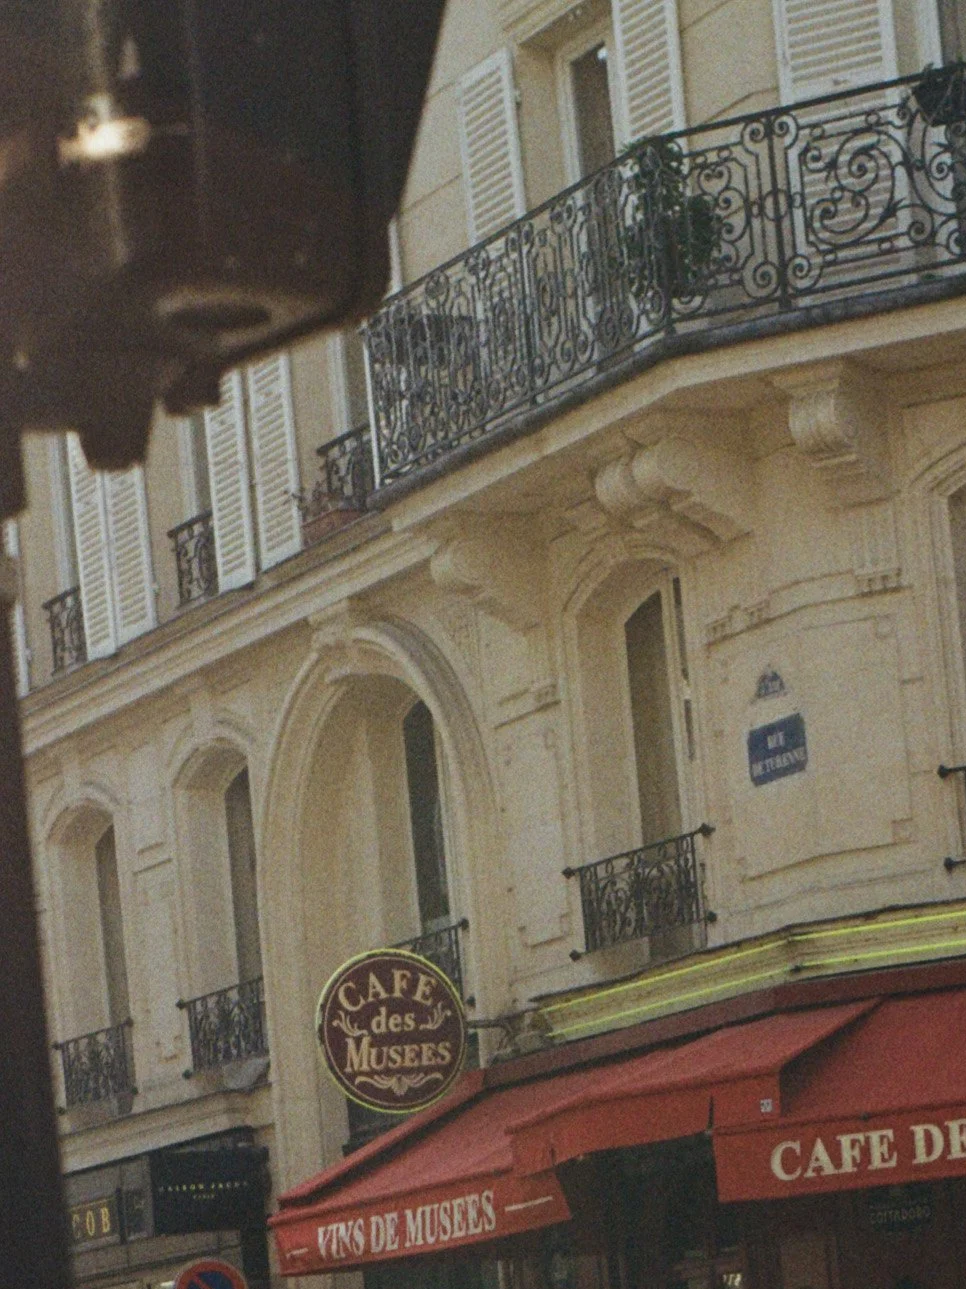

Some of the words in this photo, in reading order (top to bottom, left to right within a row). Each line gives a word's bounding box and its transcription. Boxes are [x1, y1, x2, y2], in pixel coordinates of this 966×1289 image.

[338, 968, 437, 1012] CAFE
[371, 1006, 416, 1034] des
[344, 1036, 451, 1074] MUSEES
[770, 1129, 897, 1181] CAFE
[317, 1218, 365, 1260] VINS
[370, 1212, 400, 1253] DE
[404, 1189, 496, 1248] MUSEES
